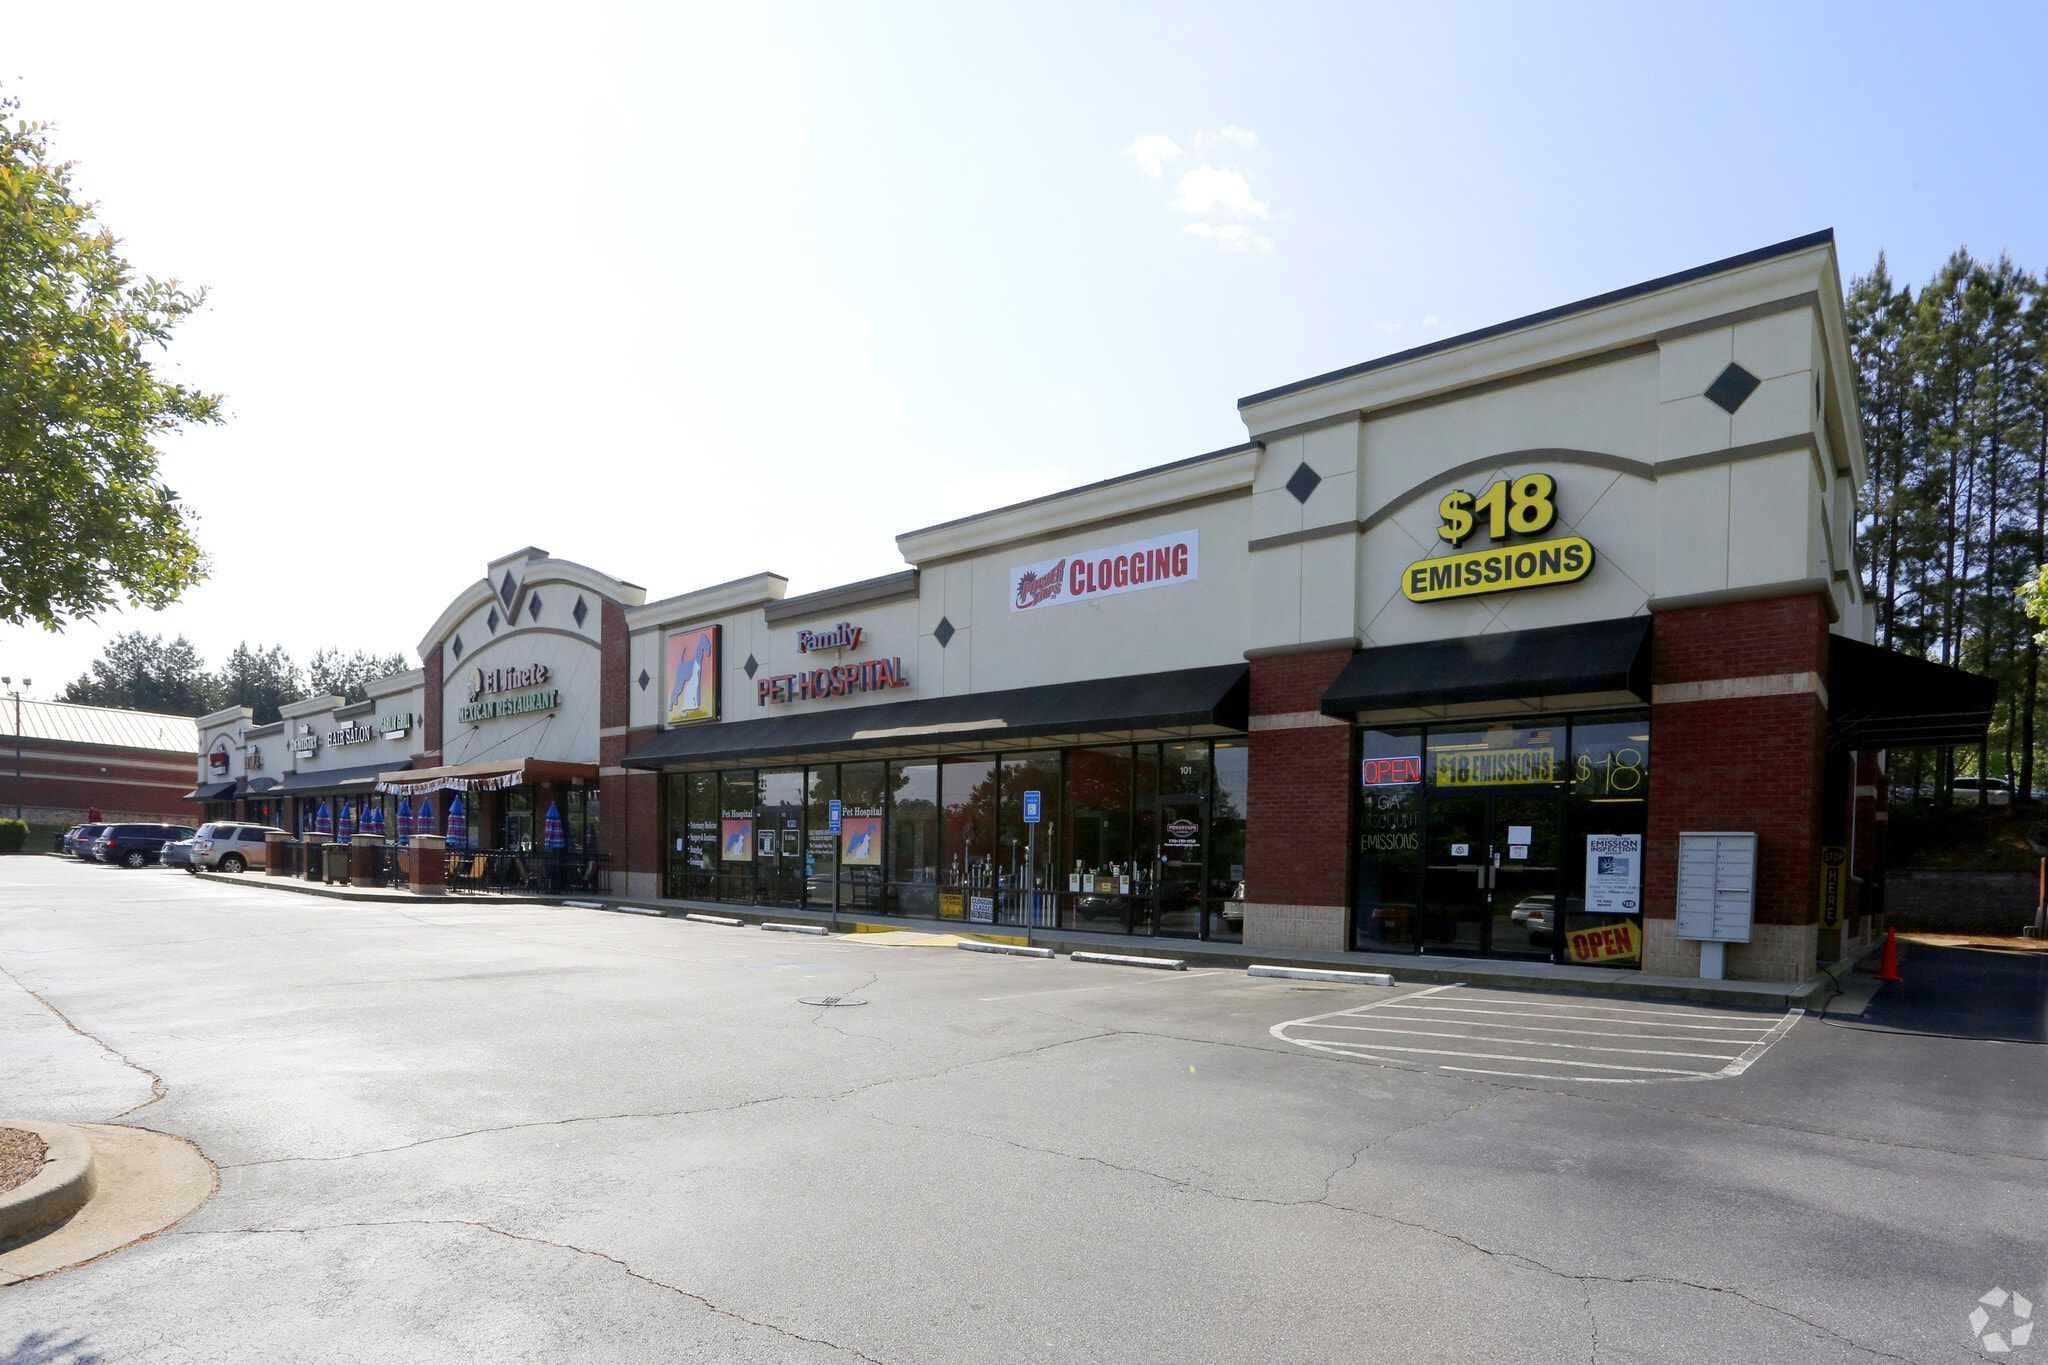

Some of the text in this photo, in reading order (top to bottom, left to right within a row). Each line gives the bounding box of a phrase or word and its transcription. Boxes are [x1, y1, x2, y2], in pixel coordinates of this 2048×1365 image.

[1437, 473, 1557, 549] $18
[1069, 543, 1188, 596] CLOGGING
[1410, 544, 1584, 594] EMISSIONS
[796, 622, 863, 653] Family
[484, 663, 549, 694] El Jinete
[758, 657, 909, 706] PET HOSPITAL
[458, 689, 558, 723] MEXICAN RESTAURANT
[327, 730, 345, 747] HAIR
[345, 725, 372, 745] SALON
[1180, 766, 1192, 774] 101
[1364, 759, 1419, 784] OPEN
[1439, 751, 1550, 783] $18 EMISSIONS
[1576, 748, 1642, 794] $18
[722, 809, 753, 820] Pet Hospital
[842, 806, 882, 818] Pet Hospital
[1378, 795, 1400, 810] GA
[1361, 833, 1419, 853] EMISSIONS
[1824, 852, 1844, 862] STOP
[1827, 869, 1837, 920] HERE
[1573, 926, 1634, 960] OPEN
